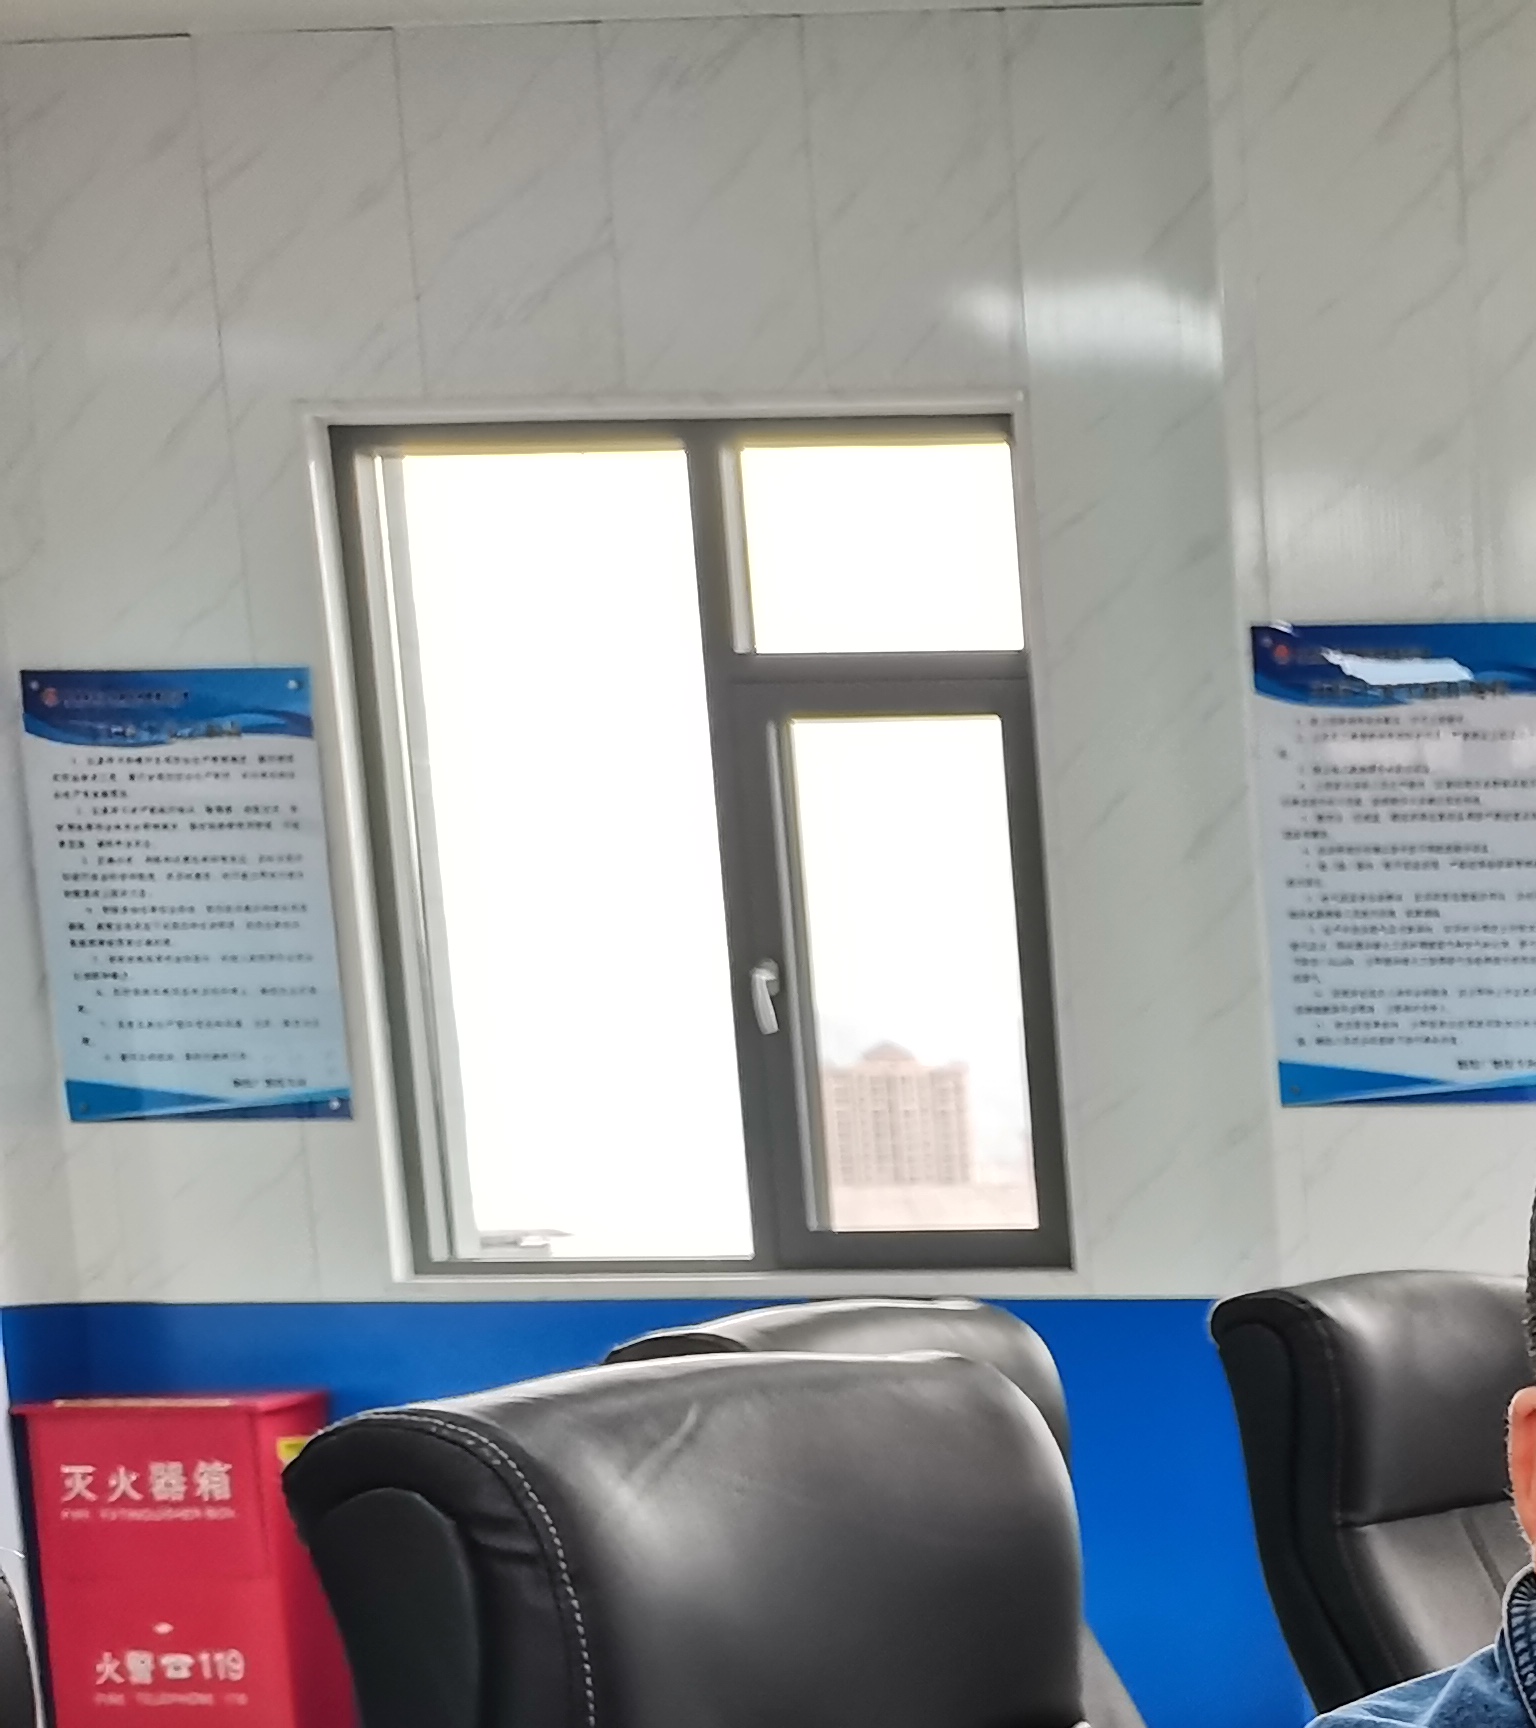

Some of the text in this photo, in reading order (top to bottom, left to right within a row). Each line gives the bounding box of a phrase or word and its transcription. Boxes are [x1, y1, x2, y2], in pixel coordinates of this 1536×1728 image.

[60, 1458, 233, 1503] 灭火器箱
[198, 1647, 246, 1682] 119
